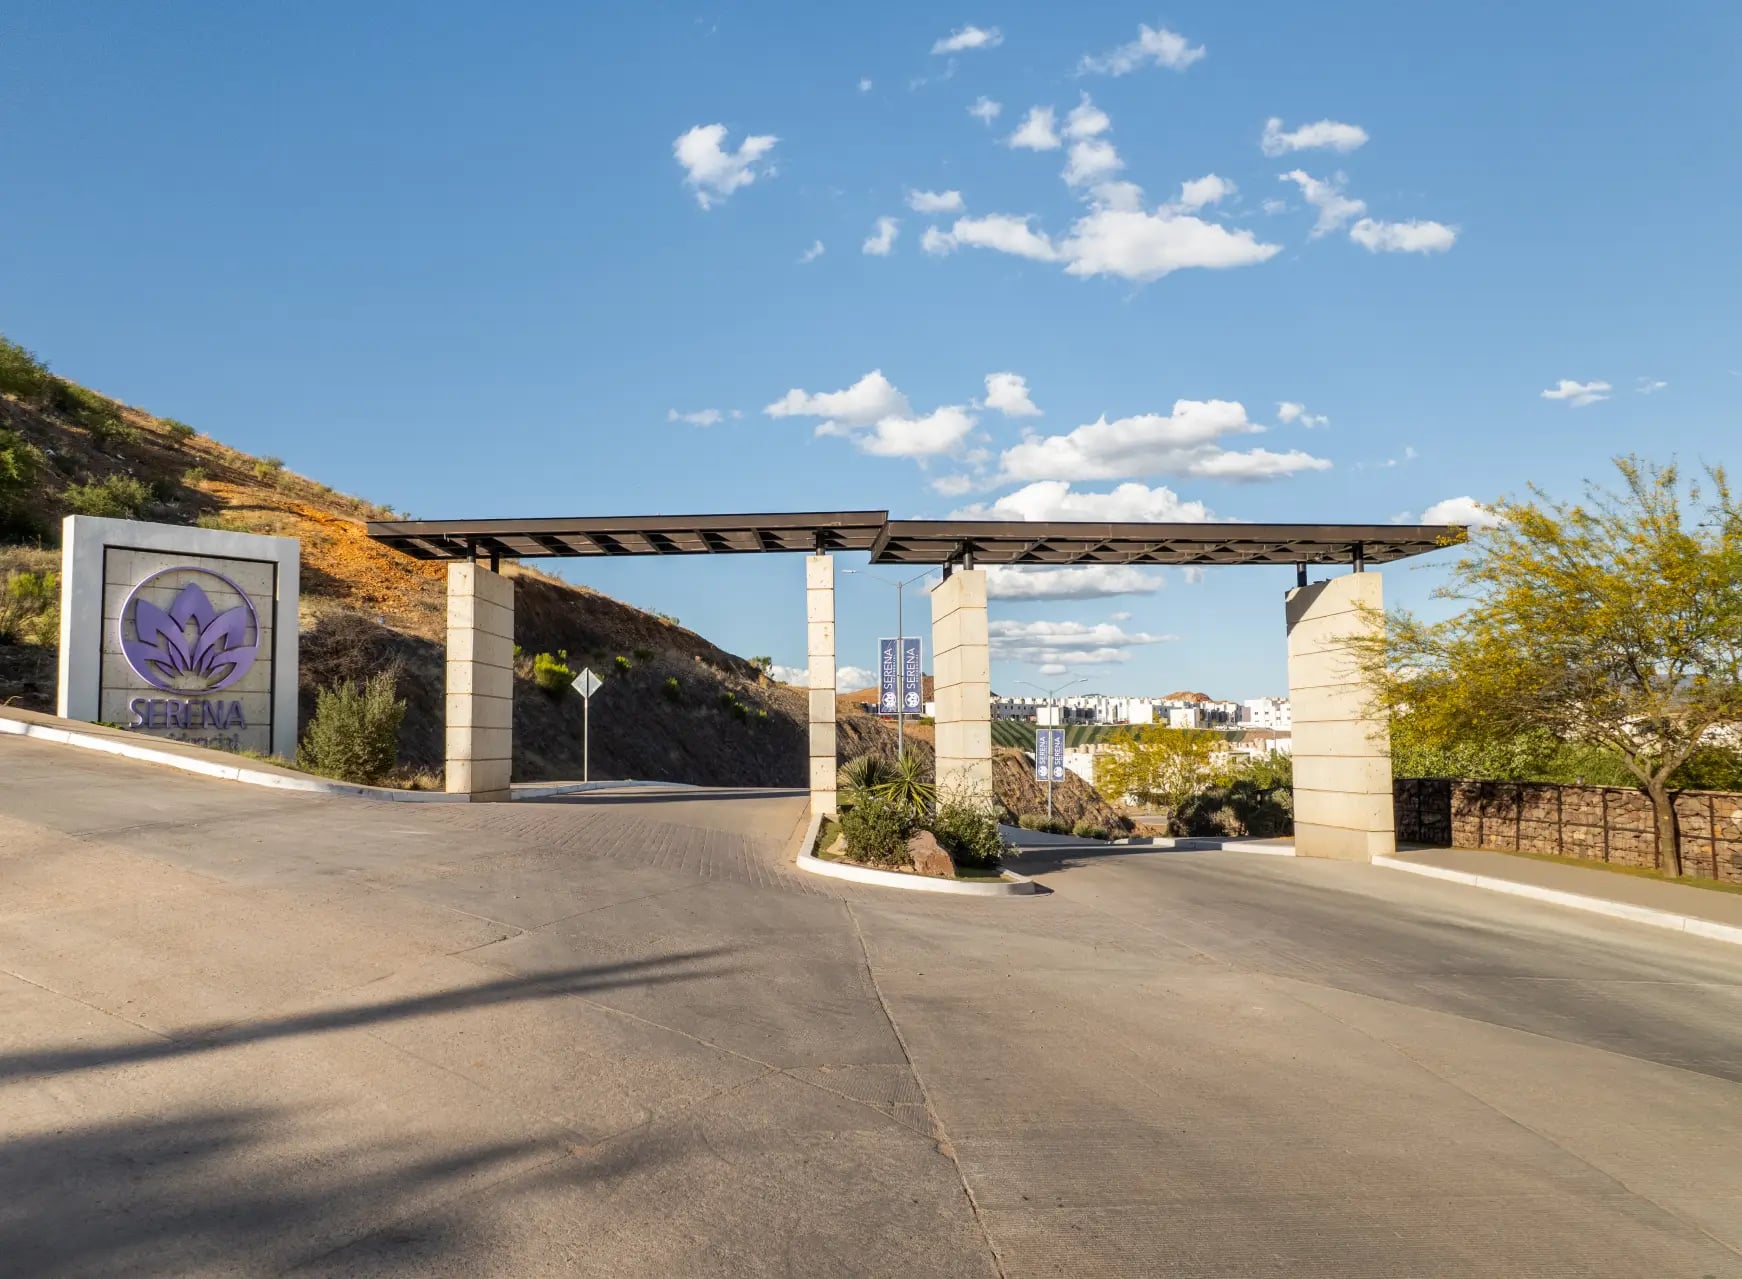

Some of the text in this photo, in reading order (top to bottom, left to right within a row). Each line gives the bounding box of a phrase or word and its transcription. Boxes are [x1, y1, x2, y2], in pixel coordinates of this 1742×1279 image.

[884, 648, 893, 689] SERENA
[907, 648, 916, 689] SERENA
[129, 698, 247, 729] SERENA
